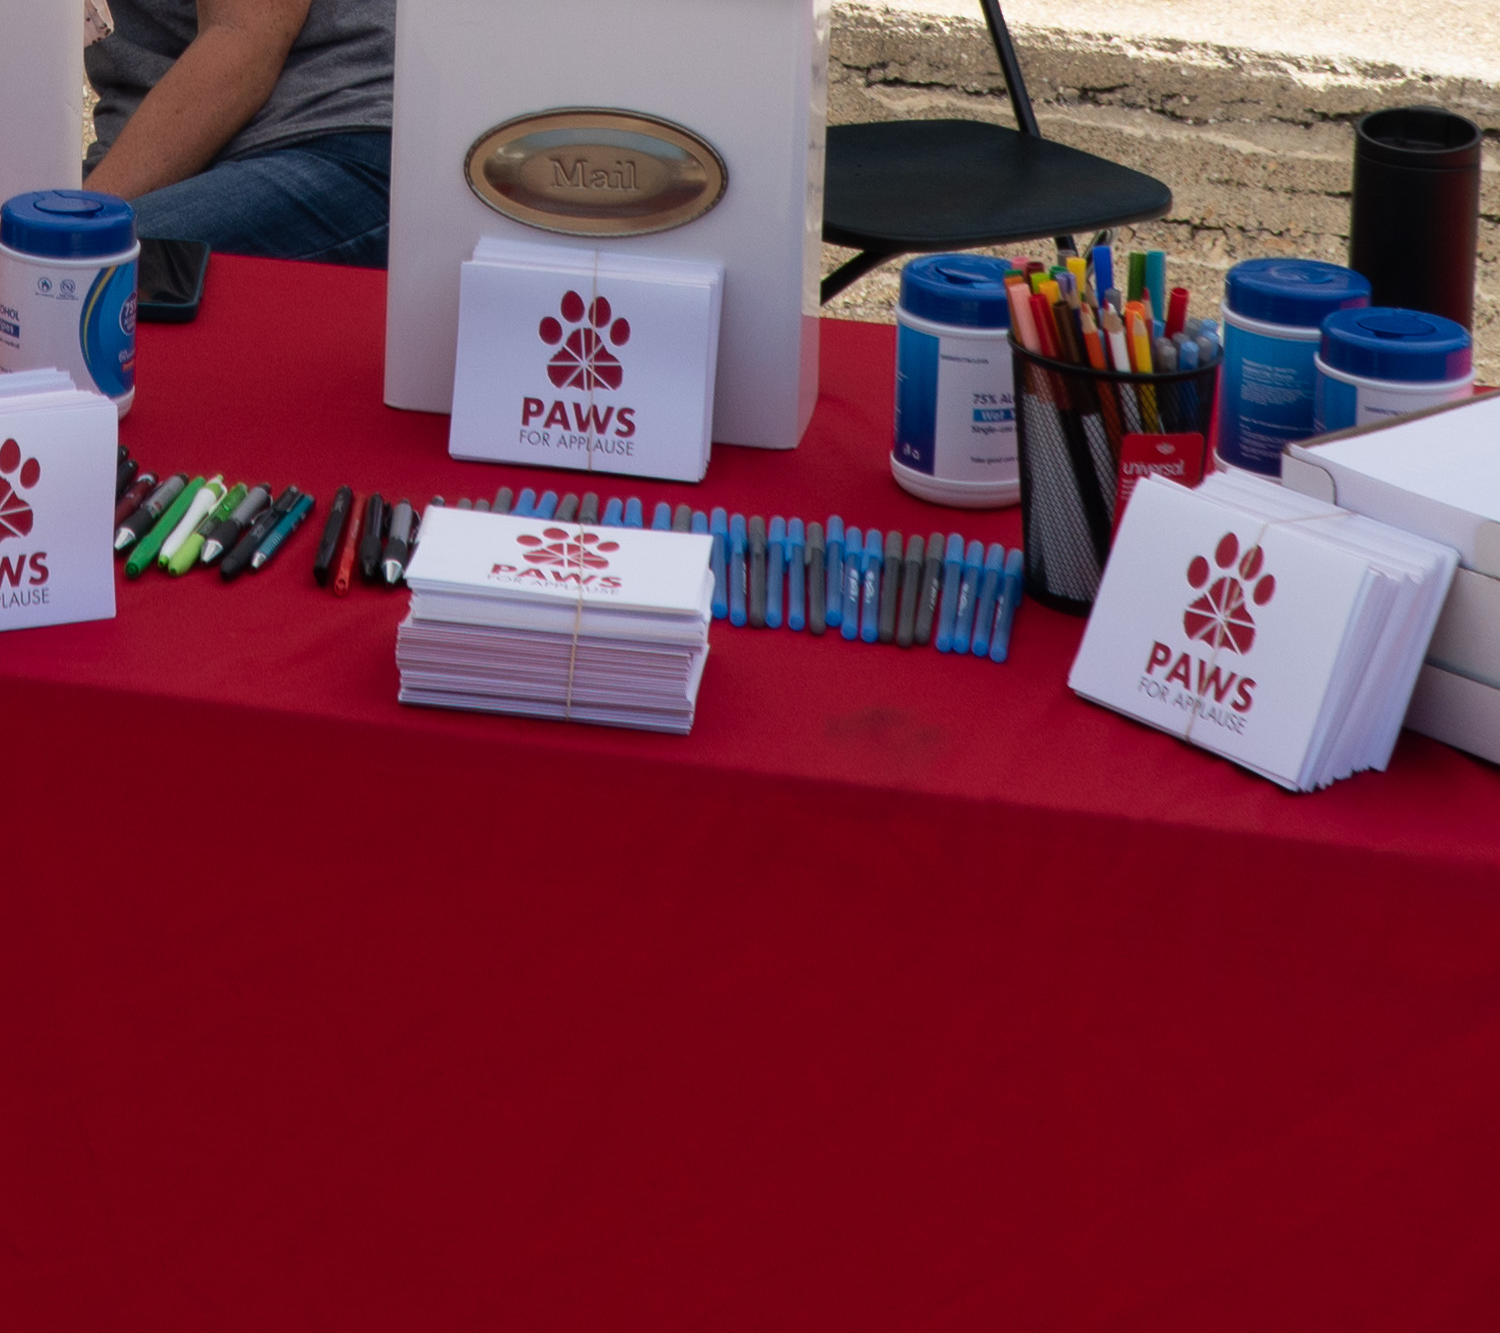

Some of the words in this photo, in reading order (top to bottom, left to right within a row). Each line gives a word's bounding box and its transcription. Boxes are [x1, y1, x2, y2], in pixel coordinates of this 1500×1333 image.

[549, 156, 640, 191] Mail
[520, 396, 636, 439] PAWS
[519, 428, 552, 448] FOR
[556, 432, 635, 458] APPLAUSE
[1122, 460, 1185, 477] universal
[490, 563, 623, 589] PAWS
[1146, 641, 1257, 714] PAWS
[1136, 675, 1170, 705] FOR
[1173, 688, 1248, 735] APPLAUSE
